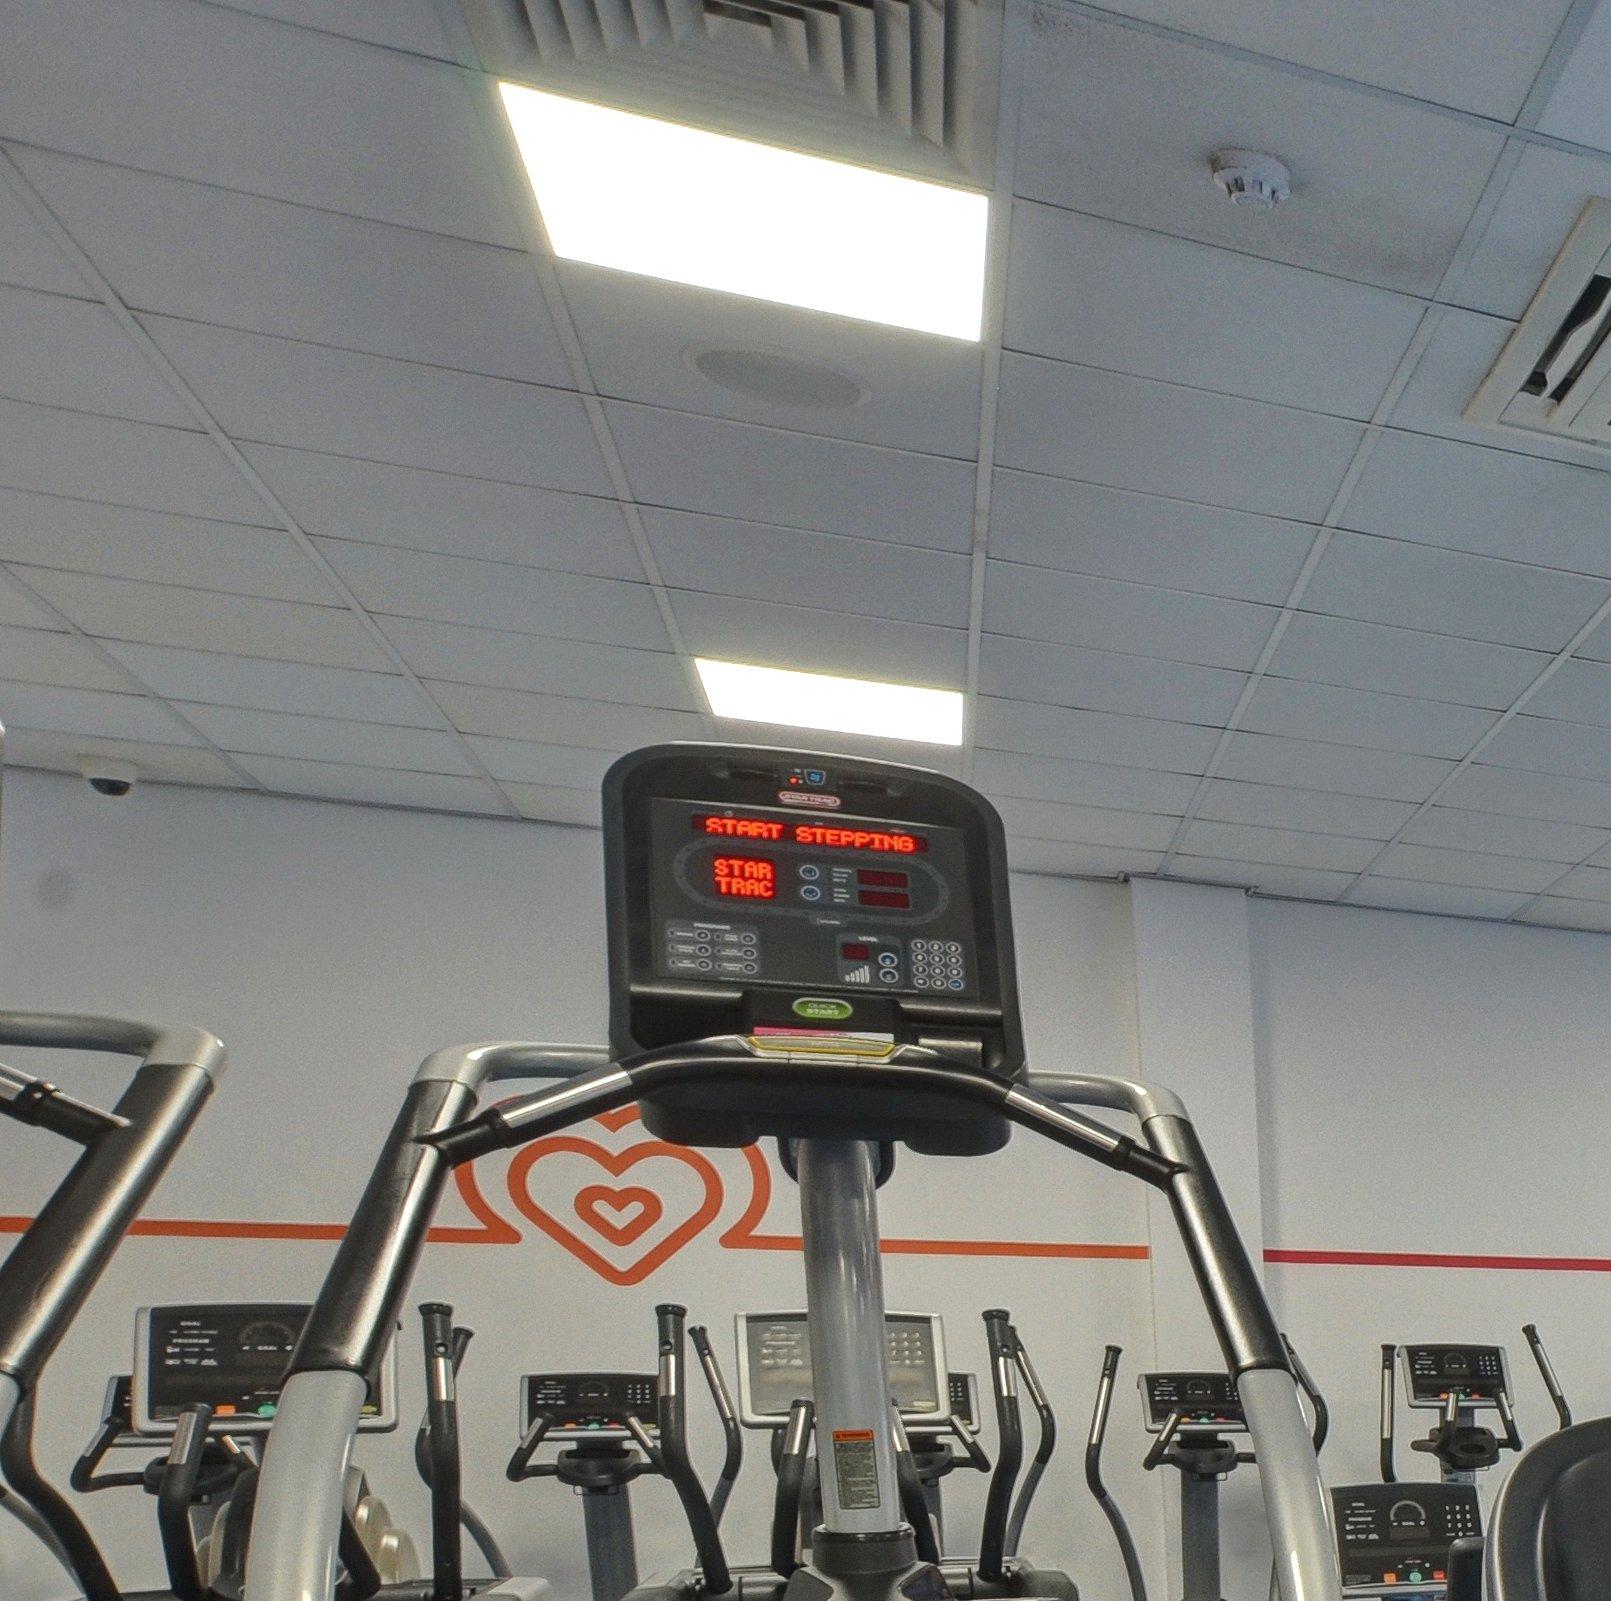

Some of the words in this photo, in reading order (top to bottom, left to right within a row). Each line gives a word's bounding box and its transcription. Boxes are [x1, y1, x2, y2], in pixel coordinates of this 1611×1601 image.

[705, 816, 784, 841] START
[795, 825, 916, 852] STEPPING
[714, 857, 773, 880] STAR
[715, 876, 774, 897] TRAC
